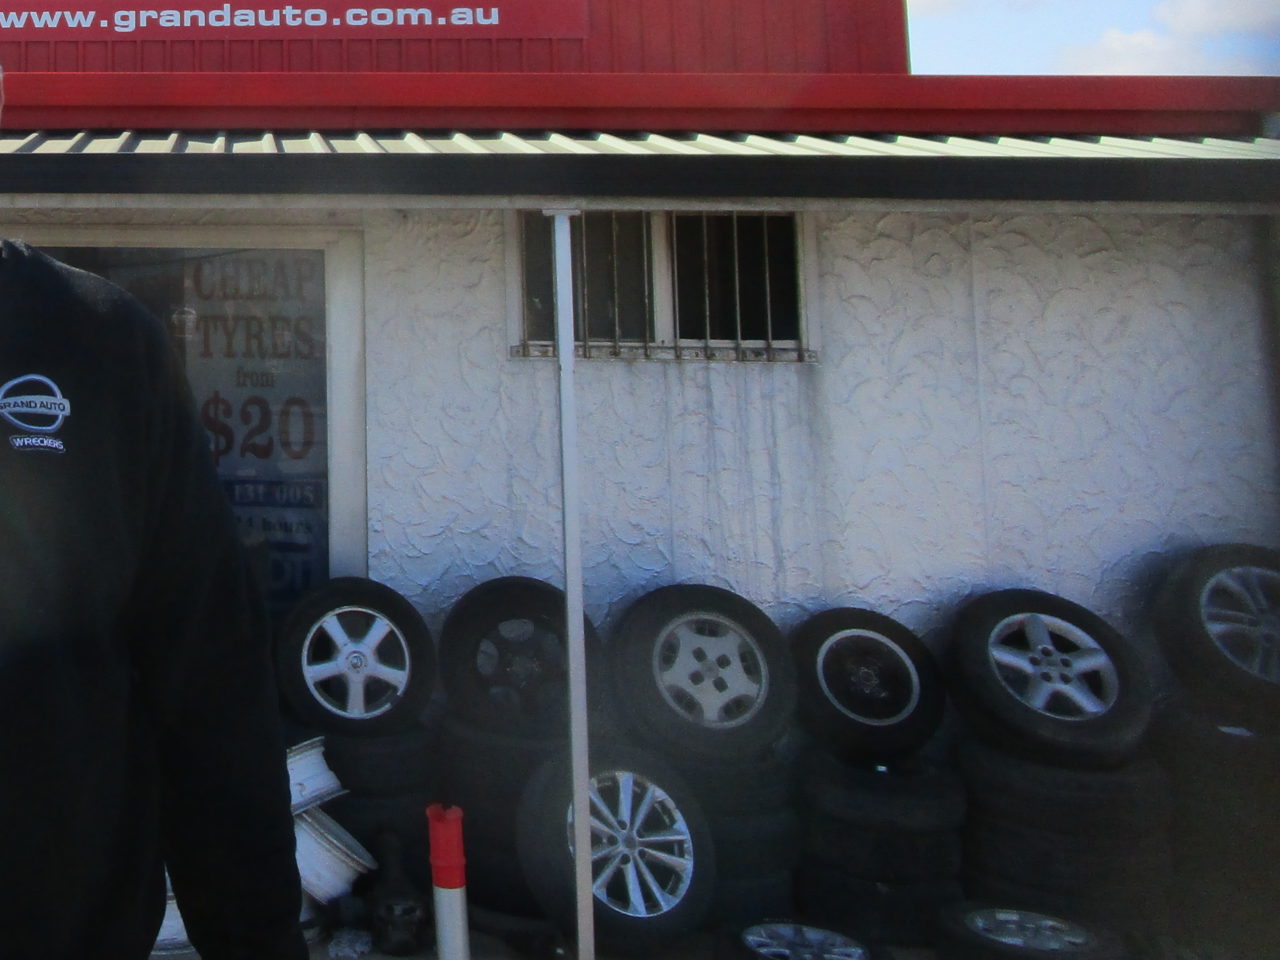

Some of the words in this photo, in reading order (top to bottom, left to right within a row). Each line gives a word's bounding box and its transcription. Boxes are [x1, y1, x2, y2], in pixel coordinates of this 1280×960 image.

[195, 314, 316, 360] TYRES
[235, 366, 277, 388] from
[38, 400, 66, 412] AUTO
[200, 391, 316, 465] $20
[12, 437, 64, 450] WRECKERS
